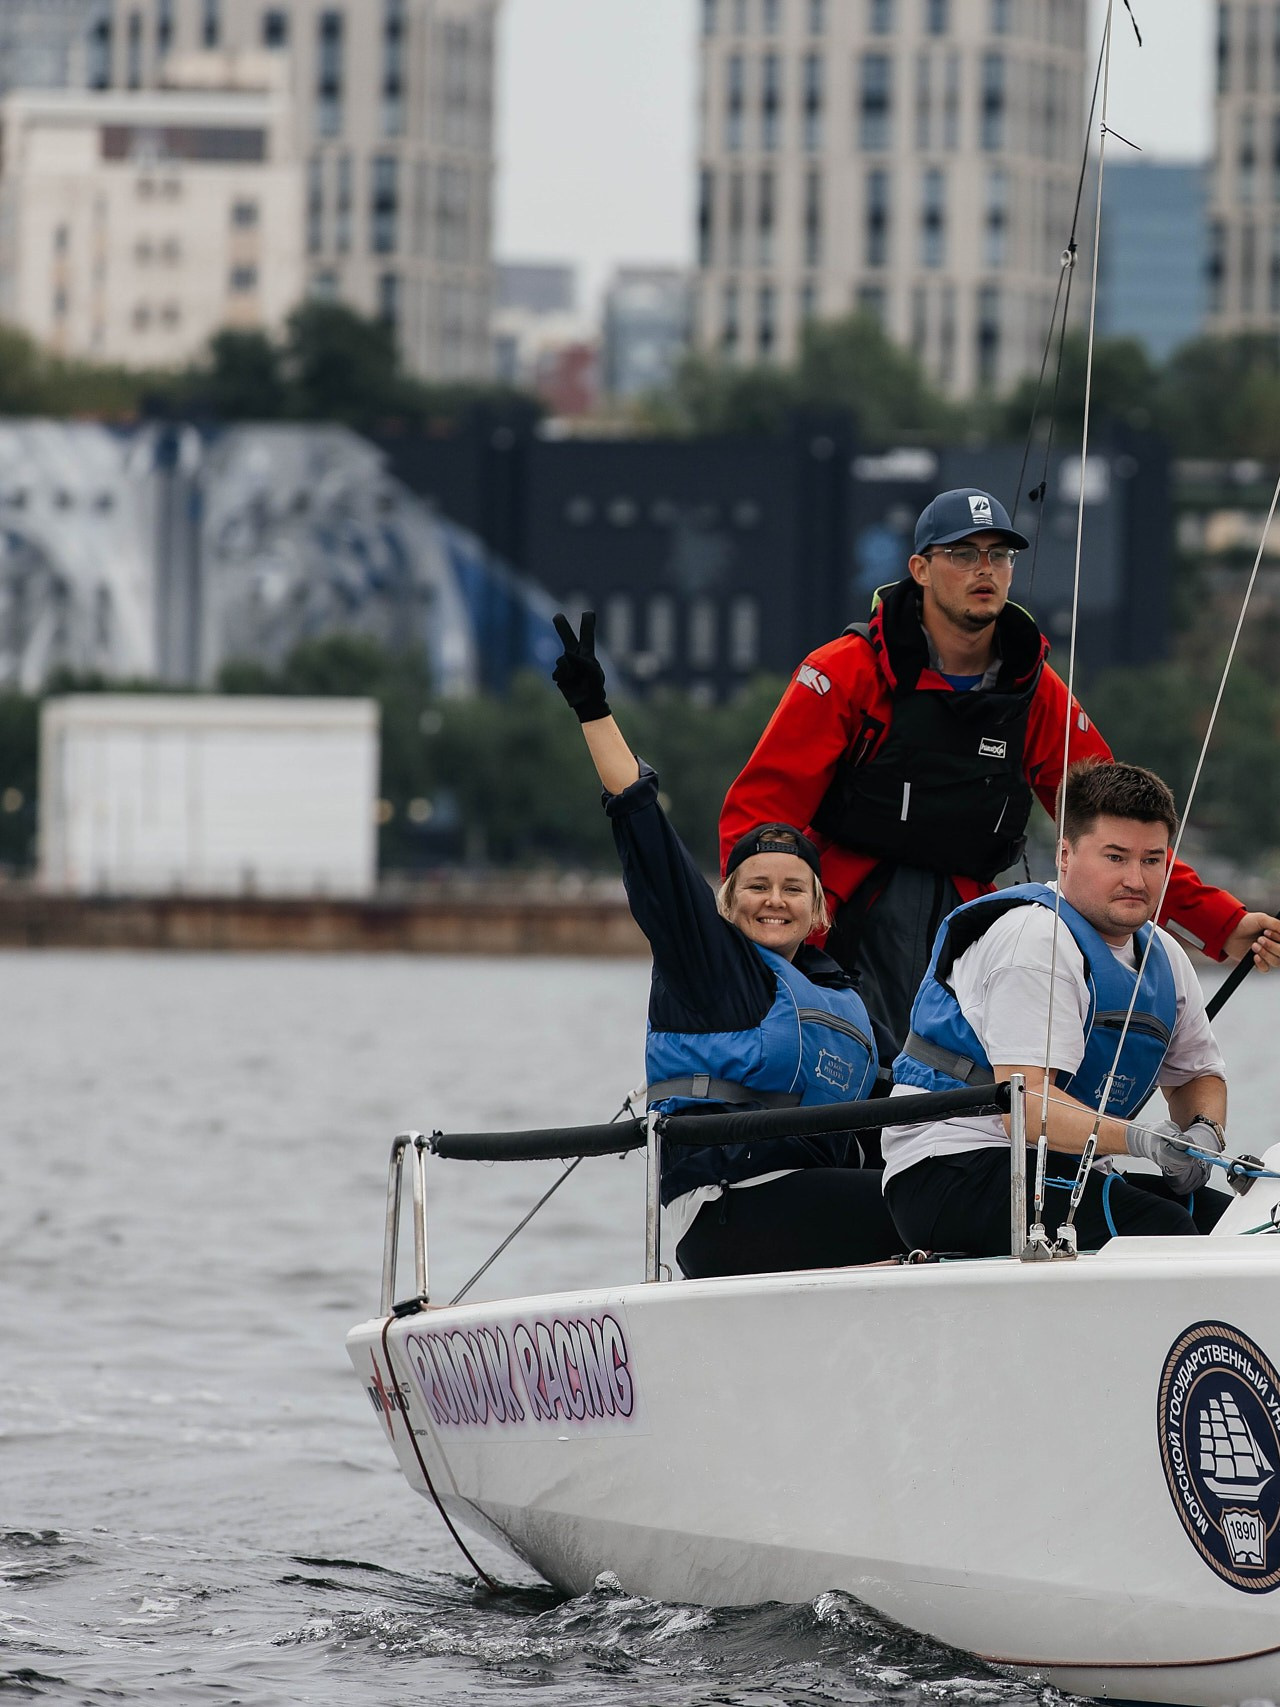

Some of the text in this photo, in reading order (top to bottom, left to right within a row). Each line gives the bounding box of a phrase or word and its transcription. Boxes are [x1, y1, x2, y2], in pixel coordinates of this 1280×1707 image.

[513, 1314, 634, 1422] RACING
[1169, 1344, 1269, 1428] ГОСУДАРСТВЕННЫЙ
[1168, 1434, 1209, 1536] МОРСКОЙ
[1230, 1520, 1257, 1541] 1890
